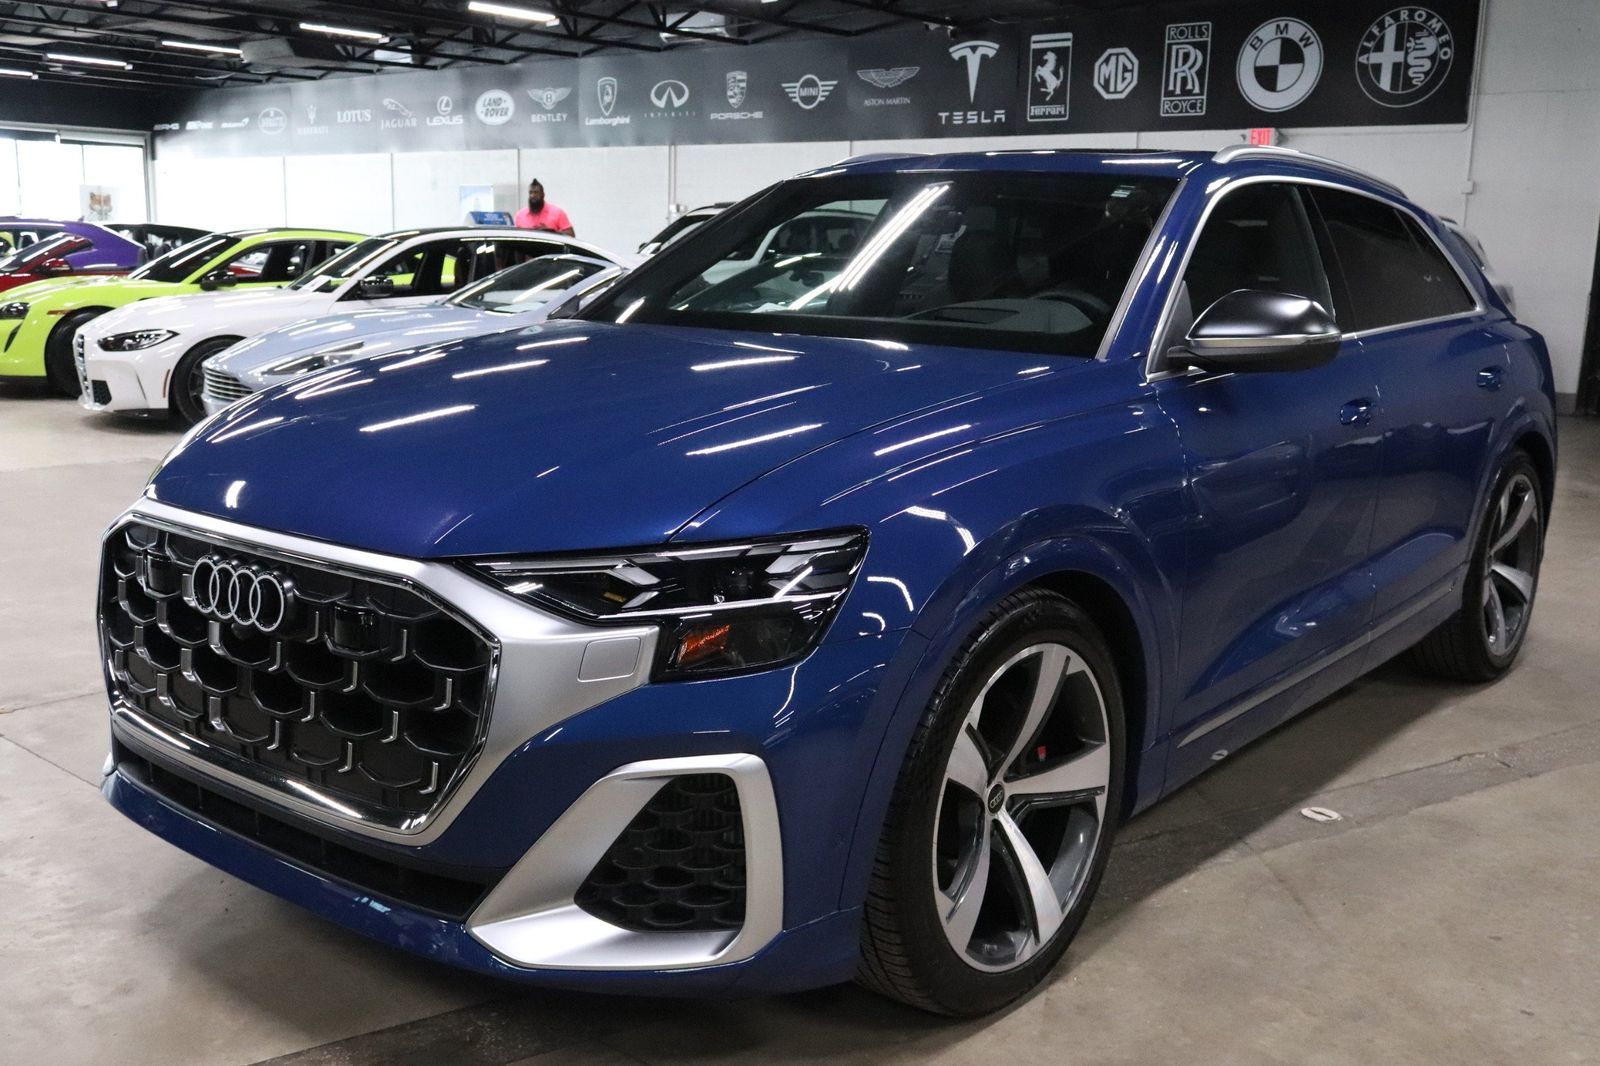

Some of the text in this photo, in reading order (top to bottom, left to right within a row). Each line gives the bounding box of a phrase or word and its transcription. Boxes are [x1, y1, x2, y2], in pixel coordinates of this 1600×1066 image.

[1169, 25, 1208, 40] ROLLS
[1249, 23, 1314, 51] BMW
[1099, 54, 1133, 93] MG
[800, 87, 819, 97] MINI
[482, 97, 503, 108] LAND
[863, 96, 911, 106] ASTON MARTIN
[1163, 99, 1203, 114] ROYCE
[337, 109, 372, 123] LOTUS
[484, 107, 510, 118] ROVER
[709, 111, 764, 120] PORSCHE
[1030, 104, 1065, 116] Ferrari
[426, 115, 464, 126] LEXUS
[531, 112, 568, 123] BENTLEY
[585, 114, 631, 127] Lamborghini
[938, 109, 1006, 125] TESLA
[381, 117, 417, 130] JAGUAR
